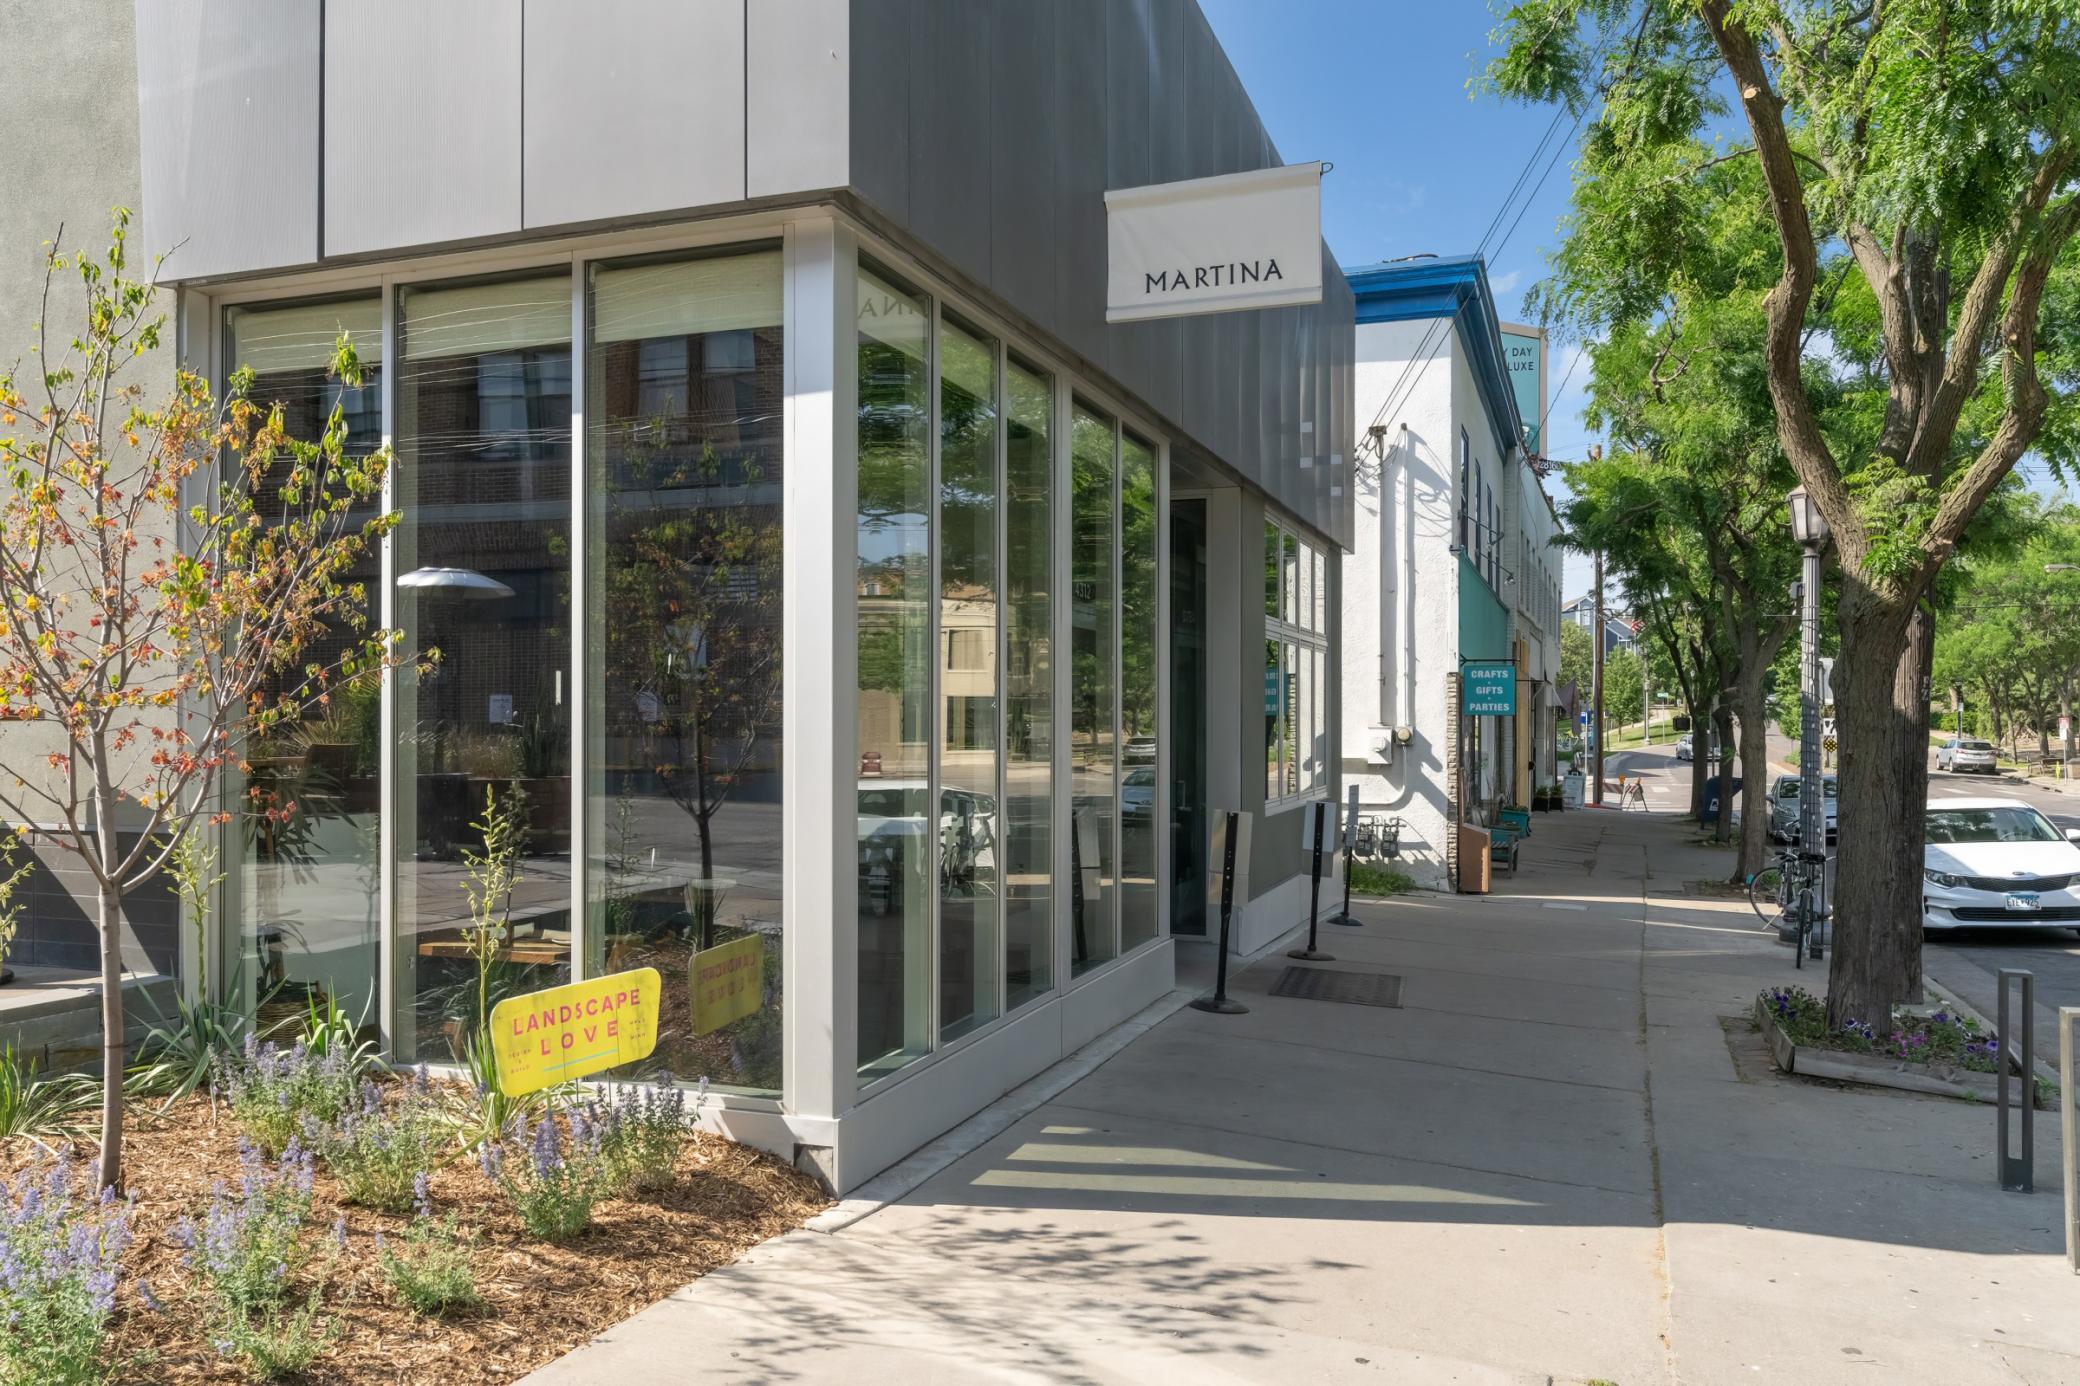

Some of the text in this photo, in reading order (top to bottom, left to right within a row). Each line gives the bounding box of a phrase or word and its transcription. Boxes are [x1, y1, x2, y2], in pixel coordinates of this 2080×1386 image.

[1145, 259, 1283, 293] MARTINA
[1512, 347, 1532, 356] DAY
[1508, 361, 1534, 371] LUXE
[1471, 670, 1509, 678] CRAFTS
[1476, 686, 1504, 695] GIFTS
[1470, 703, 1510, 711] PARTIES
[513, 988, 640, 1036] LANDSCAPE
[541, 1020, 618, 1056] LOVE
